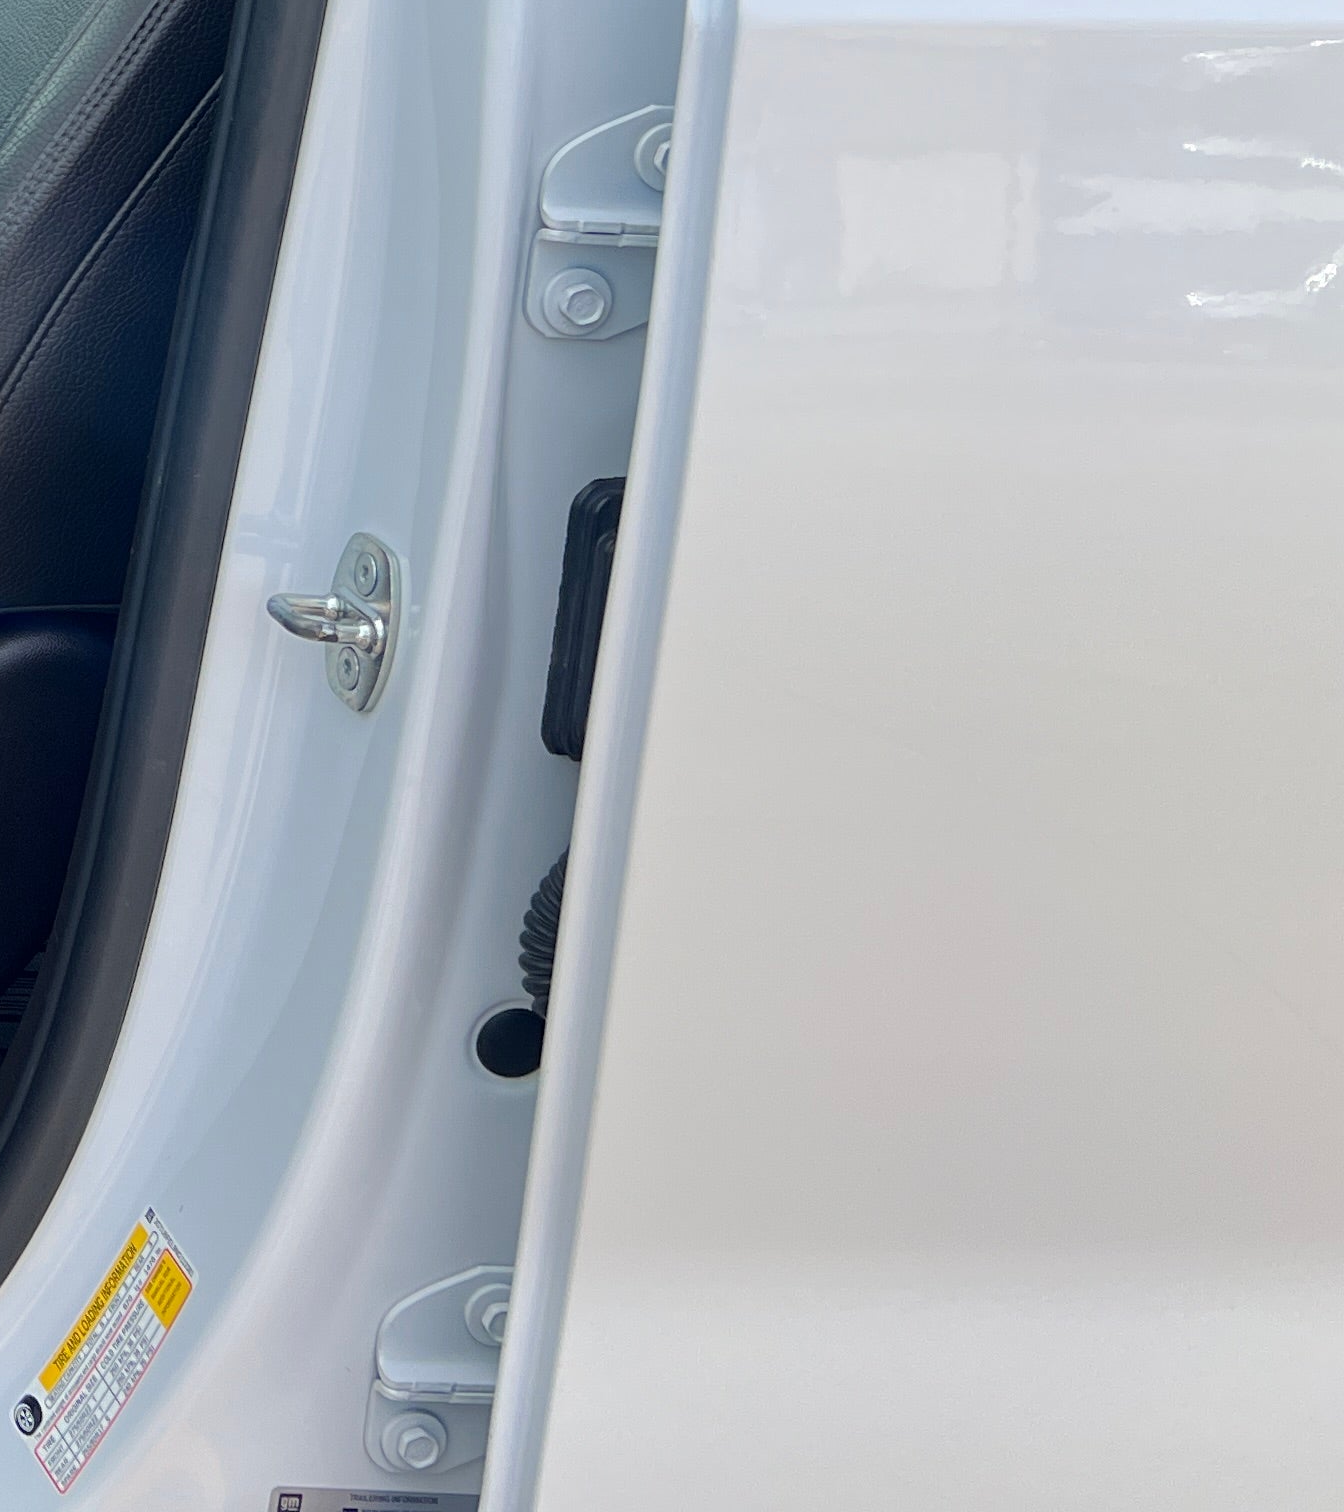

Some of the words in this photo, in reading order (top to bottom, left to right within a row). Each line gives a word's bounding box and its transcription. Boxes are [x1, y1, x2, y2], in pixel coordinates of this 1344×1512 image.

[53, 1347, 70, 1372] TIRE
[65, 1330, 81, 1353] AND
[76, 1295, 105, 1336] LOADING
[98, 1241, 139, 1301] INFORMATION
[42, 1433, 56, 1454] TIRE
[63, 1388, 87, 1425] ORIGINAL
